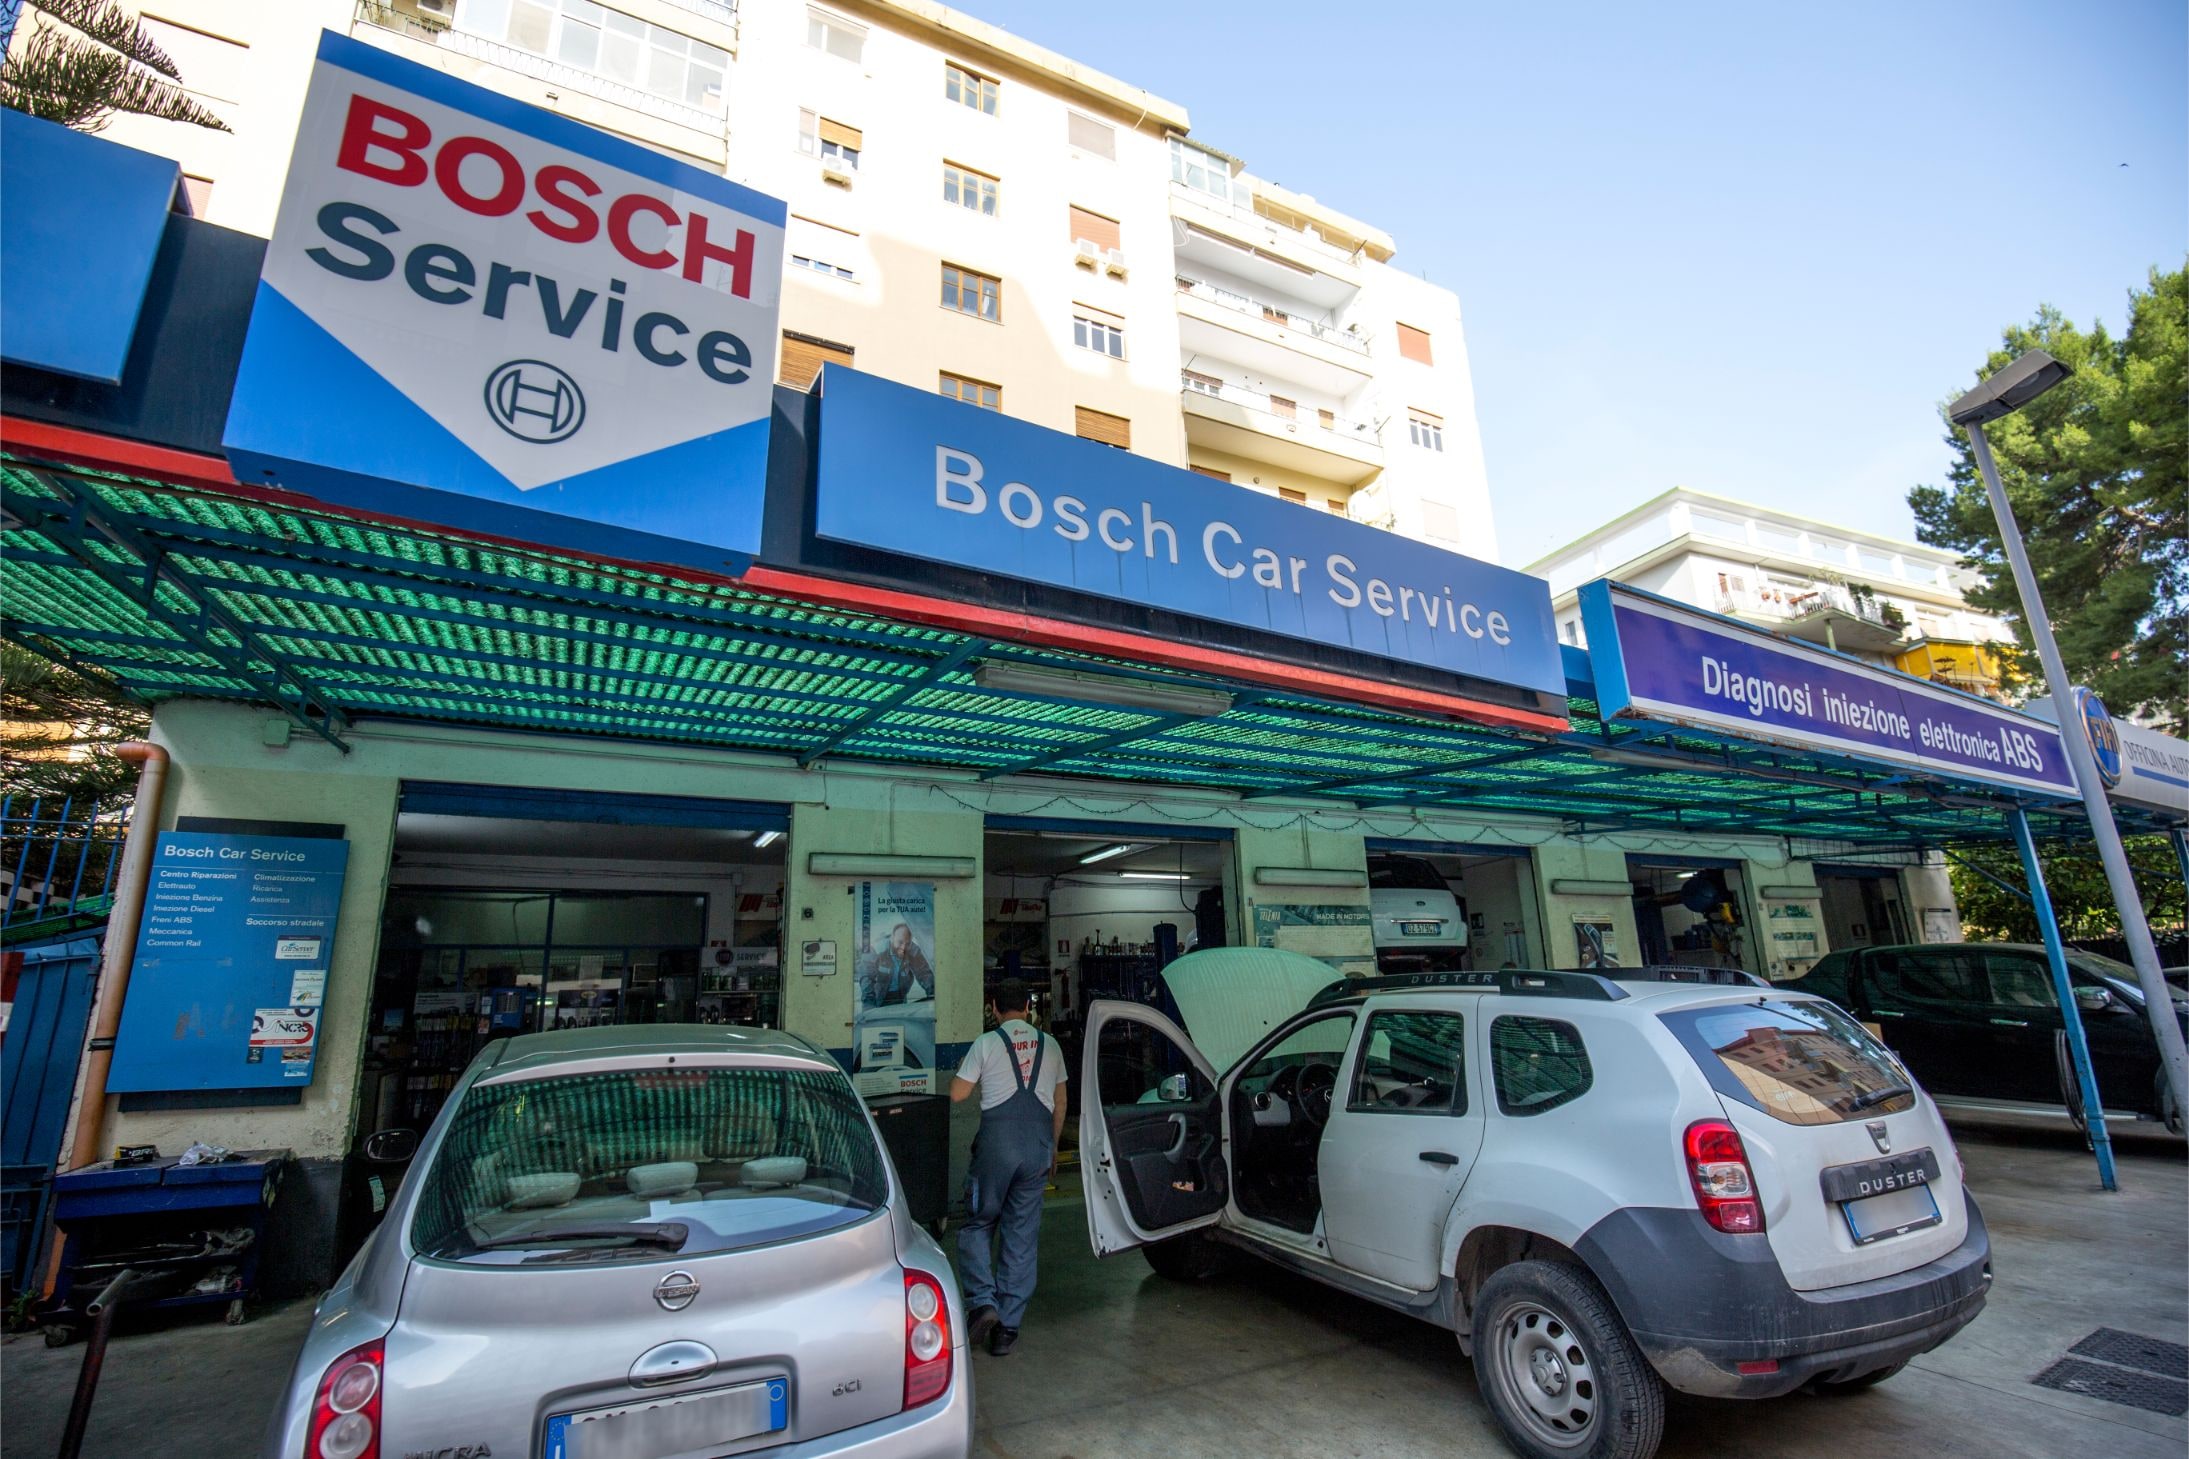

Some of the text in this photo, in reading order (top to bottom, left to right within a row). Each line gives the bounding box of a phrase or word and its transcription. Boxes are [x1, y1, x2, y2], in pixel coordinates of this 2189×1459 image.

[337, 94, 755, 300] BOSCH
[305, 201, 752, 386] Service
[935, 444, 1512, 646] Bosch Car Service
[1702, 655, 2044, 774] Diagnosi iniezione elettronica ABS
[2123, 740, 2171, 772] OFFICINA
[164, 845, 306, 862] Bosch Car Service
[191, 872, 237, 880] Riparazioni
[254, 874, 316, 882] Climatizzazione
[158, 882, 196, 890] Elettrauto
[192, 894, 223, 902] Benzina
[250, 896, 290, 904] Assistenza
[246, 918, 325, 927] Soccorso stradale
[146, 939, 184, 947] Common
[1411, 974, 1494, 984] DUSTER
[900, 1079, 927, 1088] BOSCH
[1859, 1169, 1926, 1194] DUSTER
